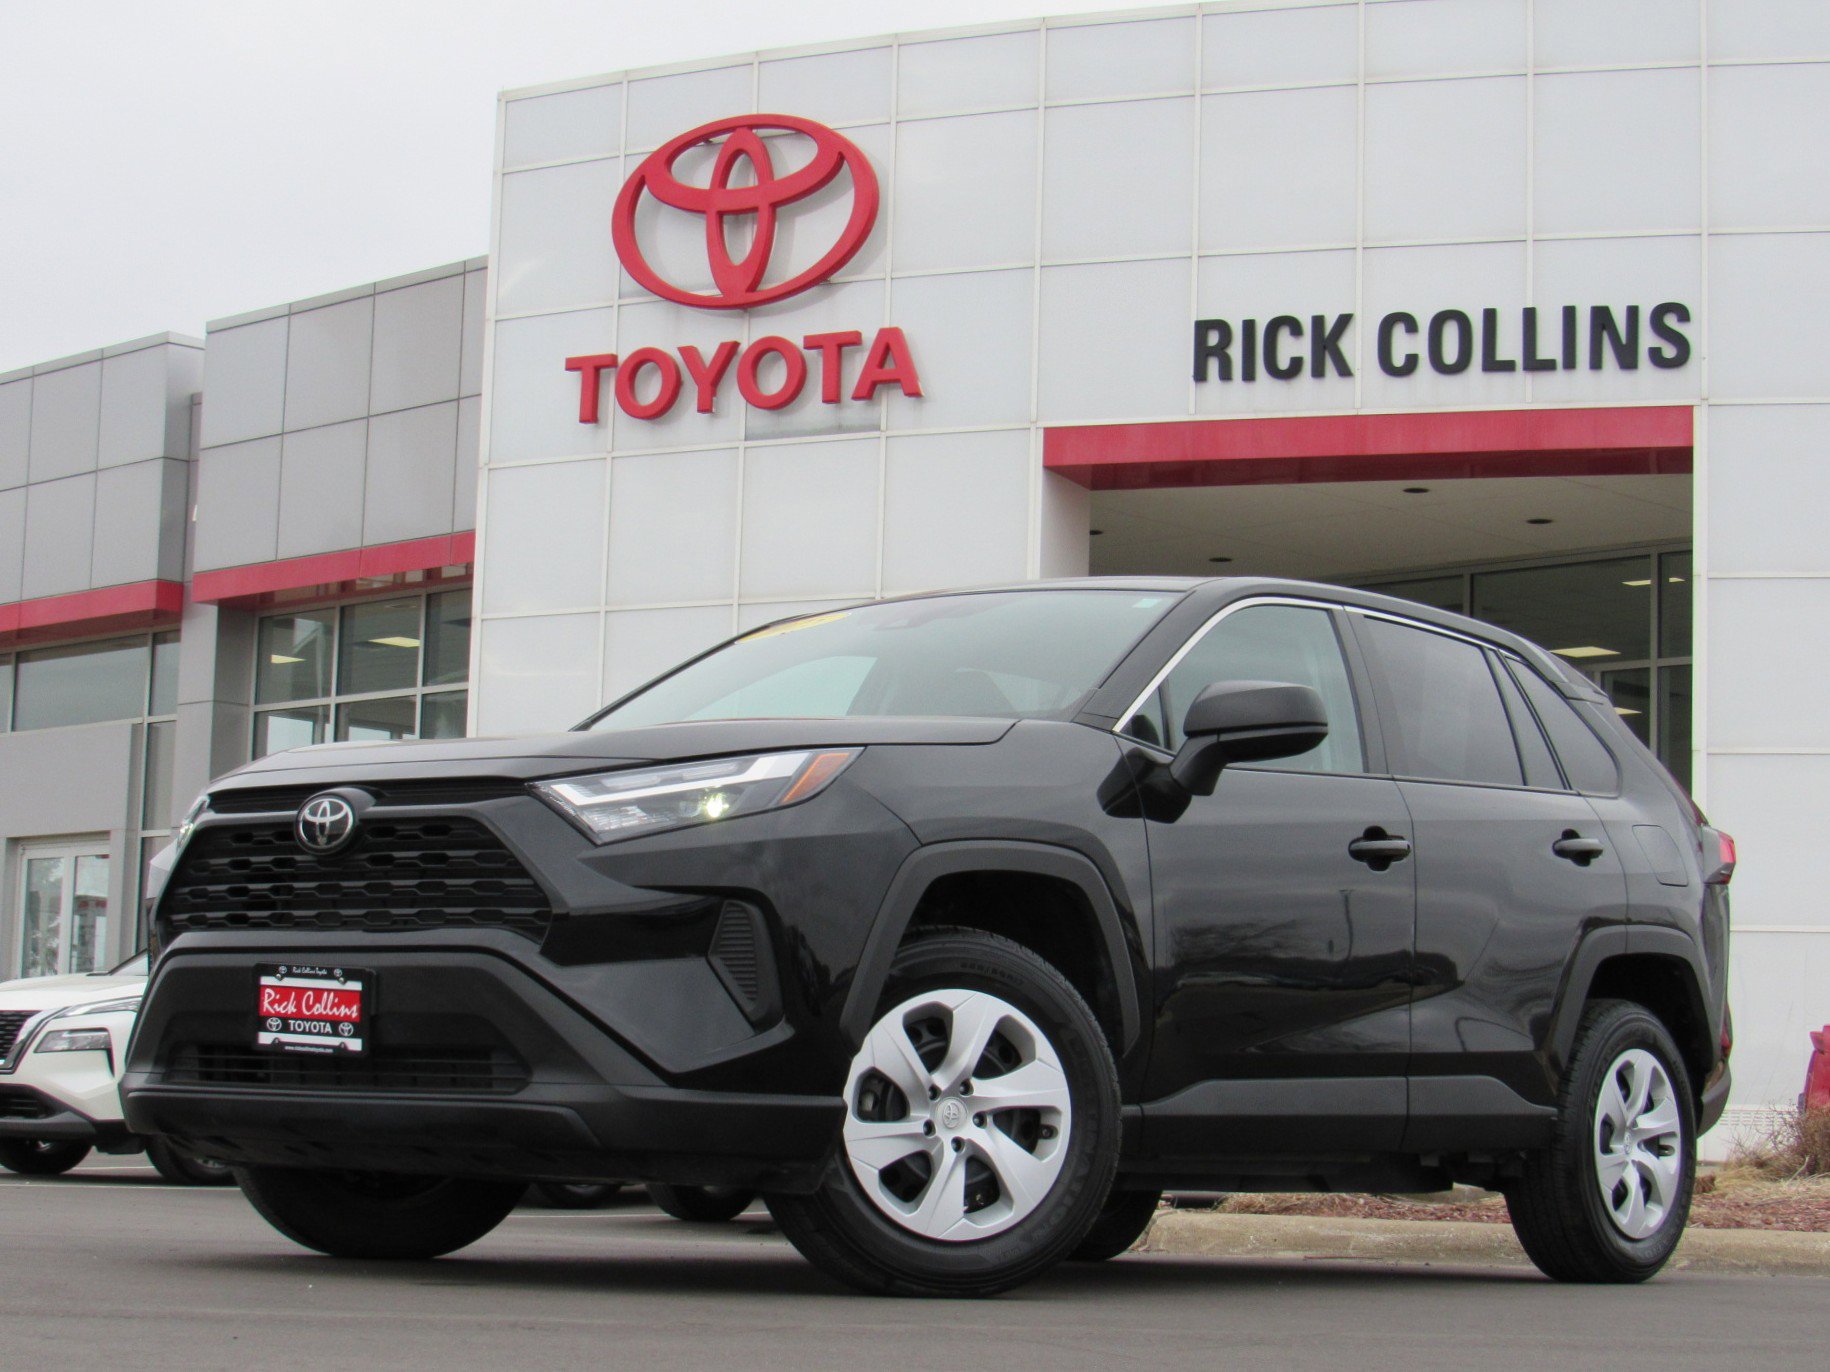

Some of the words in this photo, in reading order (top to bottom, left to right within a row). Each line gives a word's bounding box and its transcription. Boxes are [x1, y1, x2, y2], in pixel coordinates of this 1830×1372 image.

[1193, 313, 1354, 382] RICK
[1377, 302, 1691, 377] COLLINS
[565, 326, 924, 424] TOYOTA
[263, 988, 297, 1014] Rick
[302, 991, 358, 1018] Collins
[288, 1020, 333, 1034] TOYOTA
